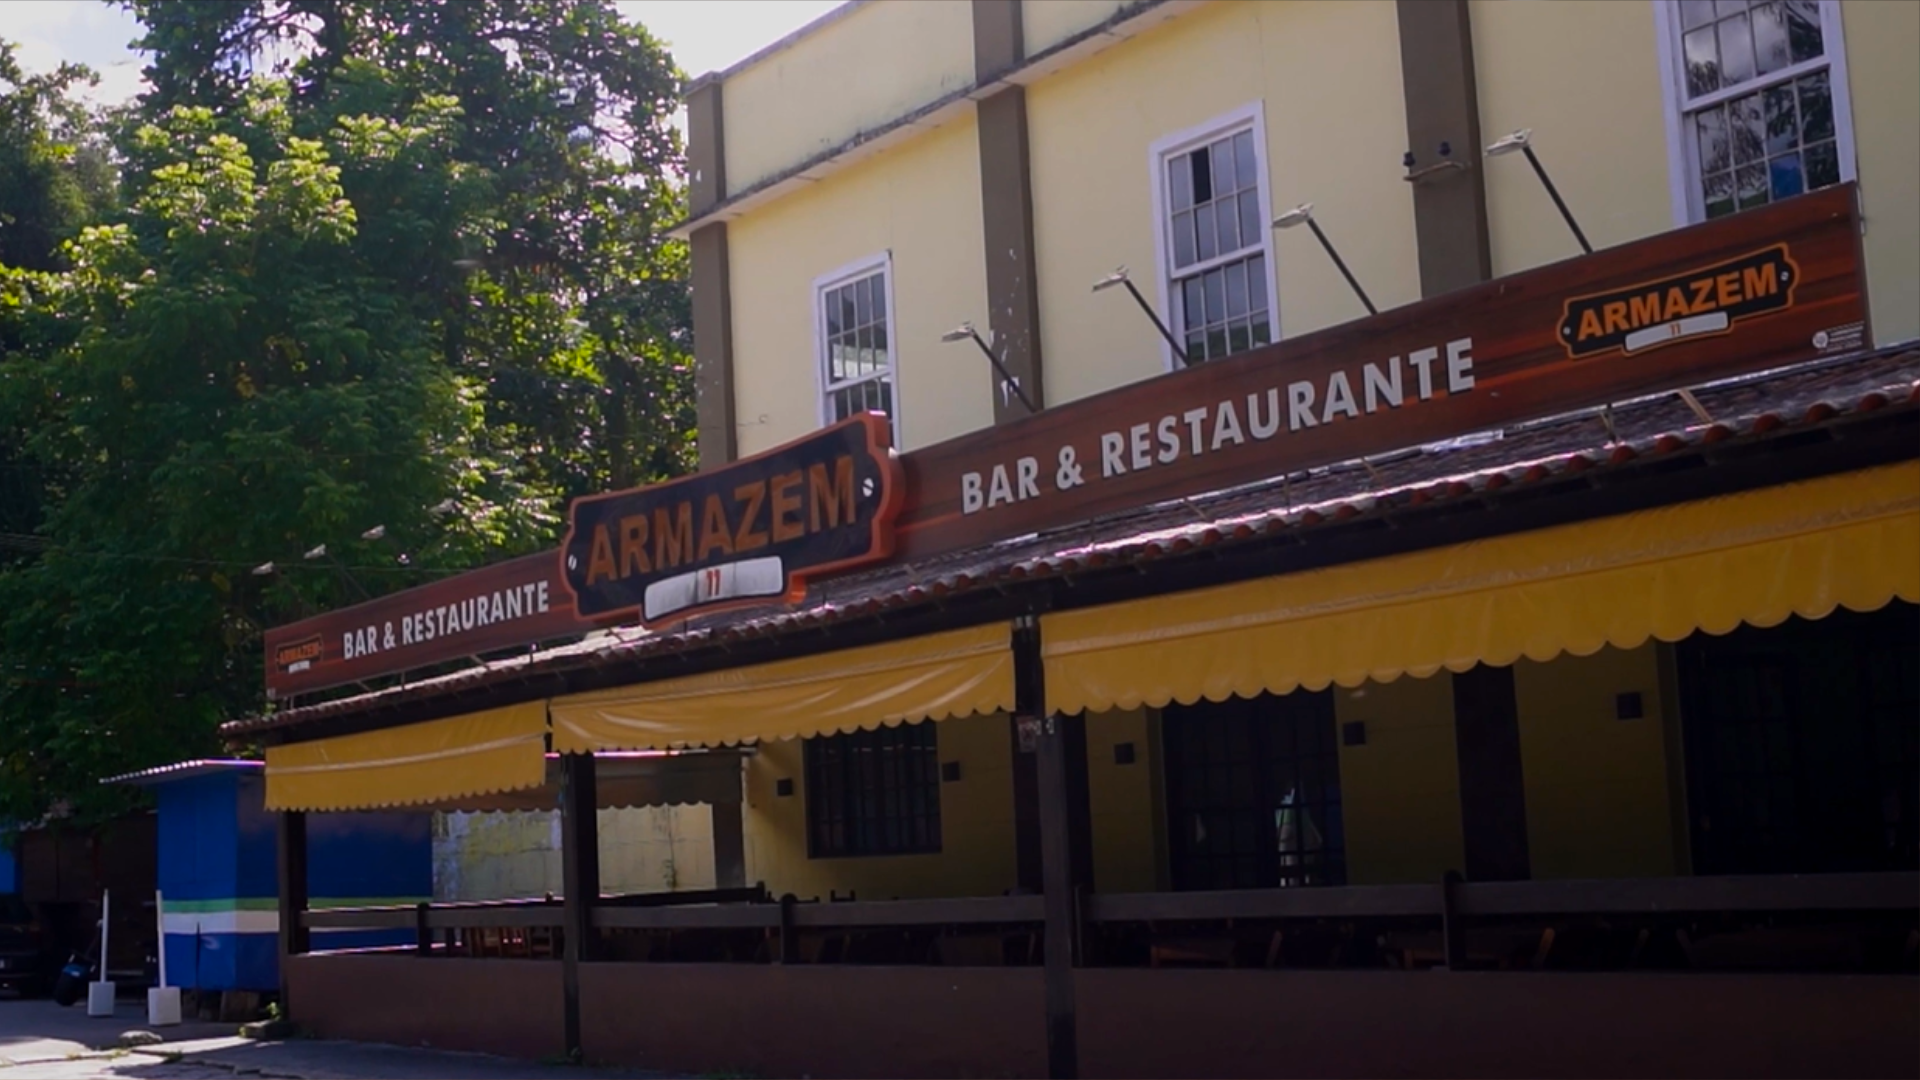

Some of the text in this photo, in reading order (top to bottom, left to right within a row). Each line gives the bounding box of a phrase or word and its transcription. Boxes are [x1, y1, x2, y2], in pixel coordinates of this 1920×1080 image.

[1577, 262, 1778, 341] ARMAZEM
[962, 337, 1476, 514] BAR & RESTAURANTE
[586, 454, 857, 586] ARMAZEM
[343, 580, 550, 660] BAR & RESTAURANTE
